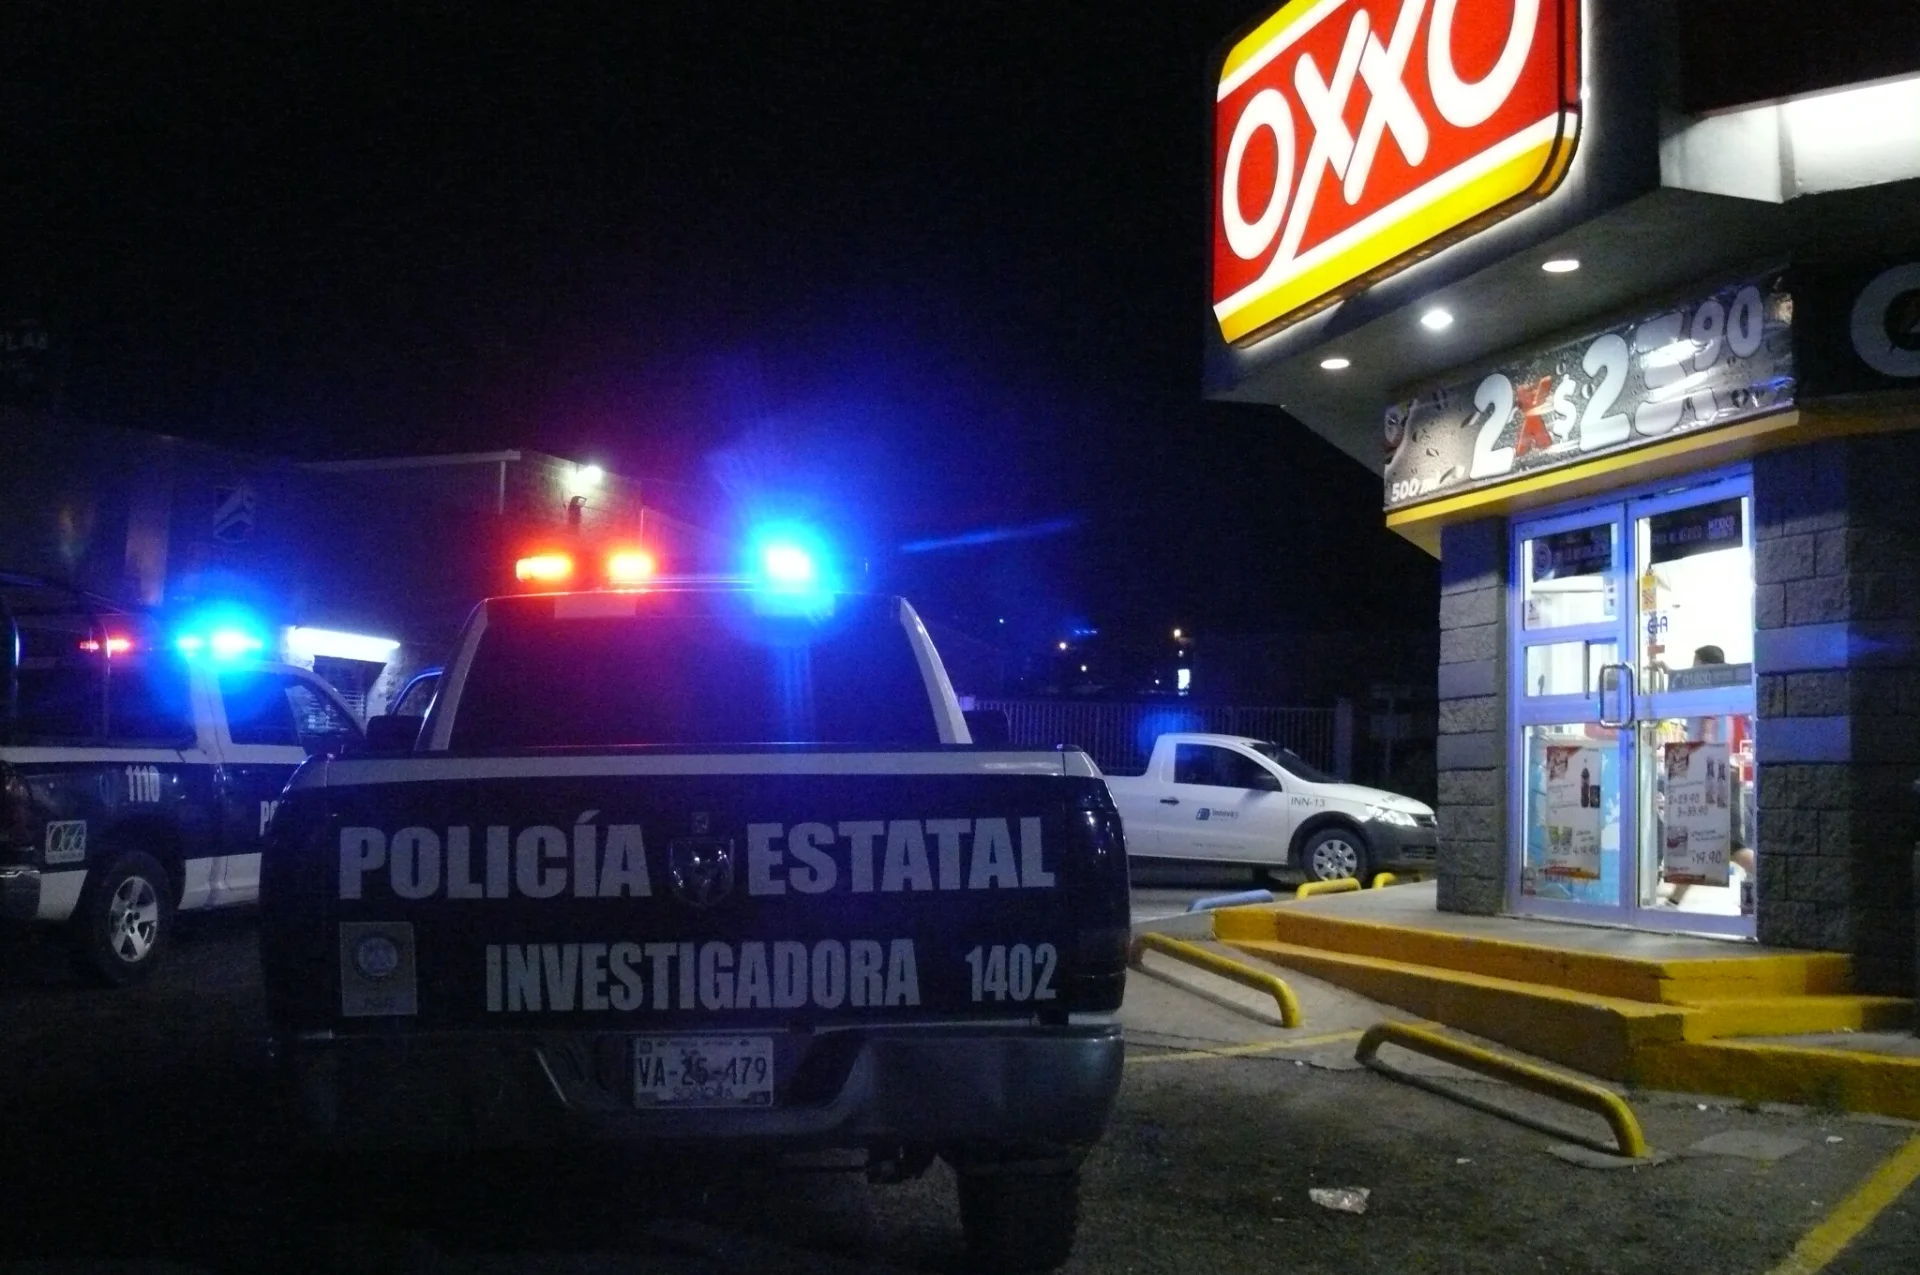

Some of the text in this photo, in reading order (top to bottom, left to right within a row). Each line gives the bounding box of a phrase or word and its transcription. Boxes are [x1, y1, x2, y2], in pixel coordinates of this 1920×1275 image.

[1222, 0, 1540, 277] OXXO
[339, 809, 1056, 899] POLICÍA ESTATAL
[486, 938, 921, 1012] INVESTIGADORA
[965, 943, 1058, 1001] 1402
